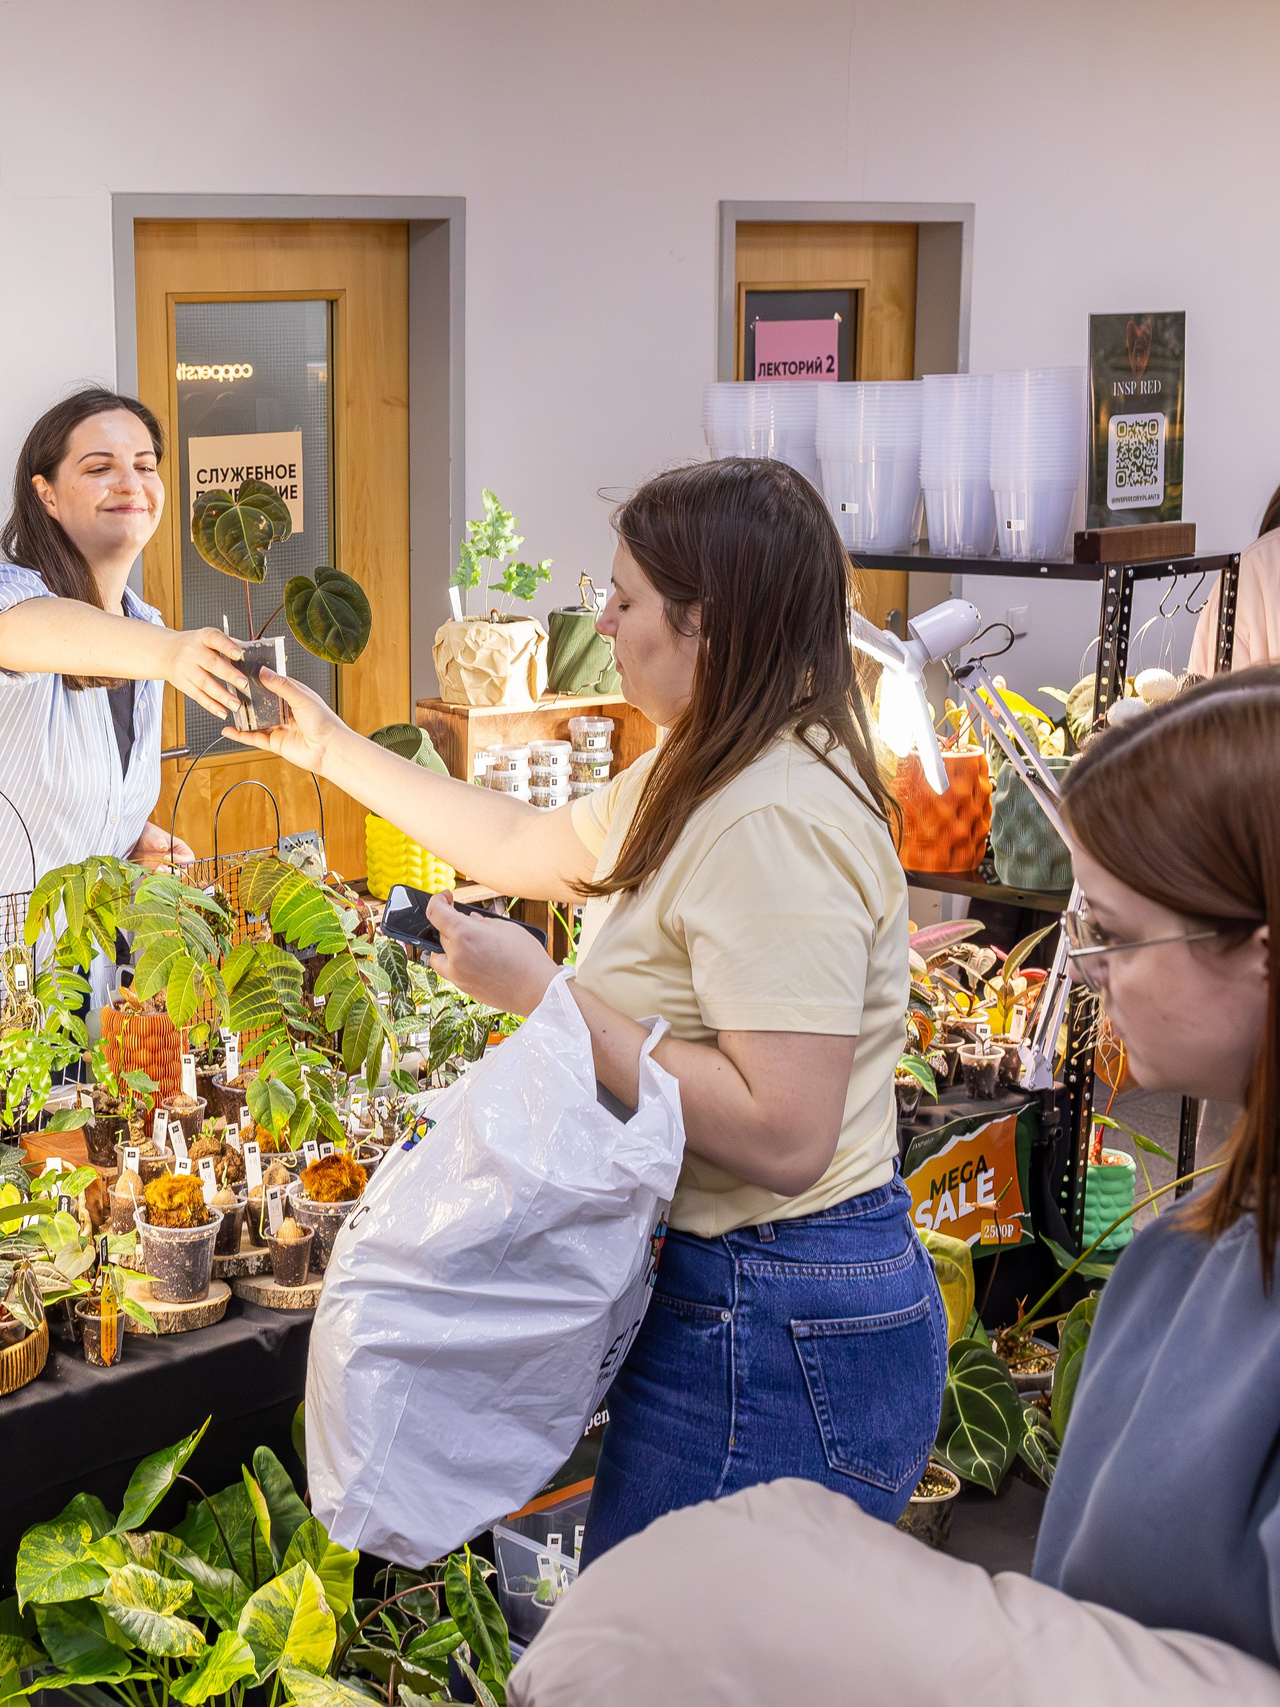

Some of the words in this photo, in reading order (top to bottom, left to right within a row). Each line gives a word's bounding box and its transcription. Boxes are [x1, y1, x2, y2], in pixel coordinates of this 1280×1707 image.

[758, 357, 822, 377] ЛЕКТОРИЙ
[826, 354, 835, 373] 2
[196, 463, 297, 484] СЛУЖЕБНОЕ
[930, 1154, 988, 1201] MEGA
[915, 1167, 995, 1231] SALE
